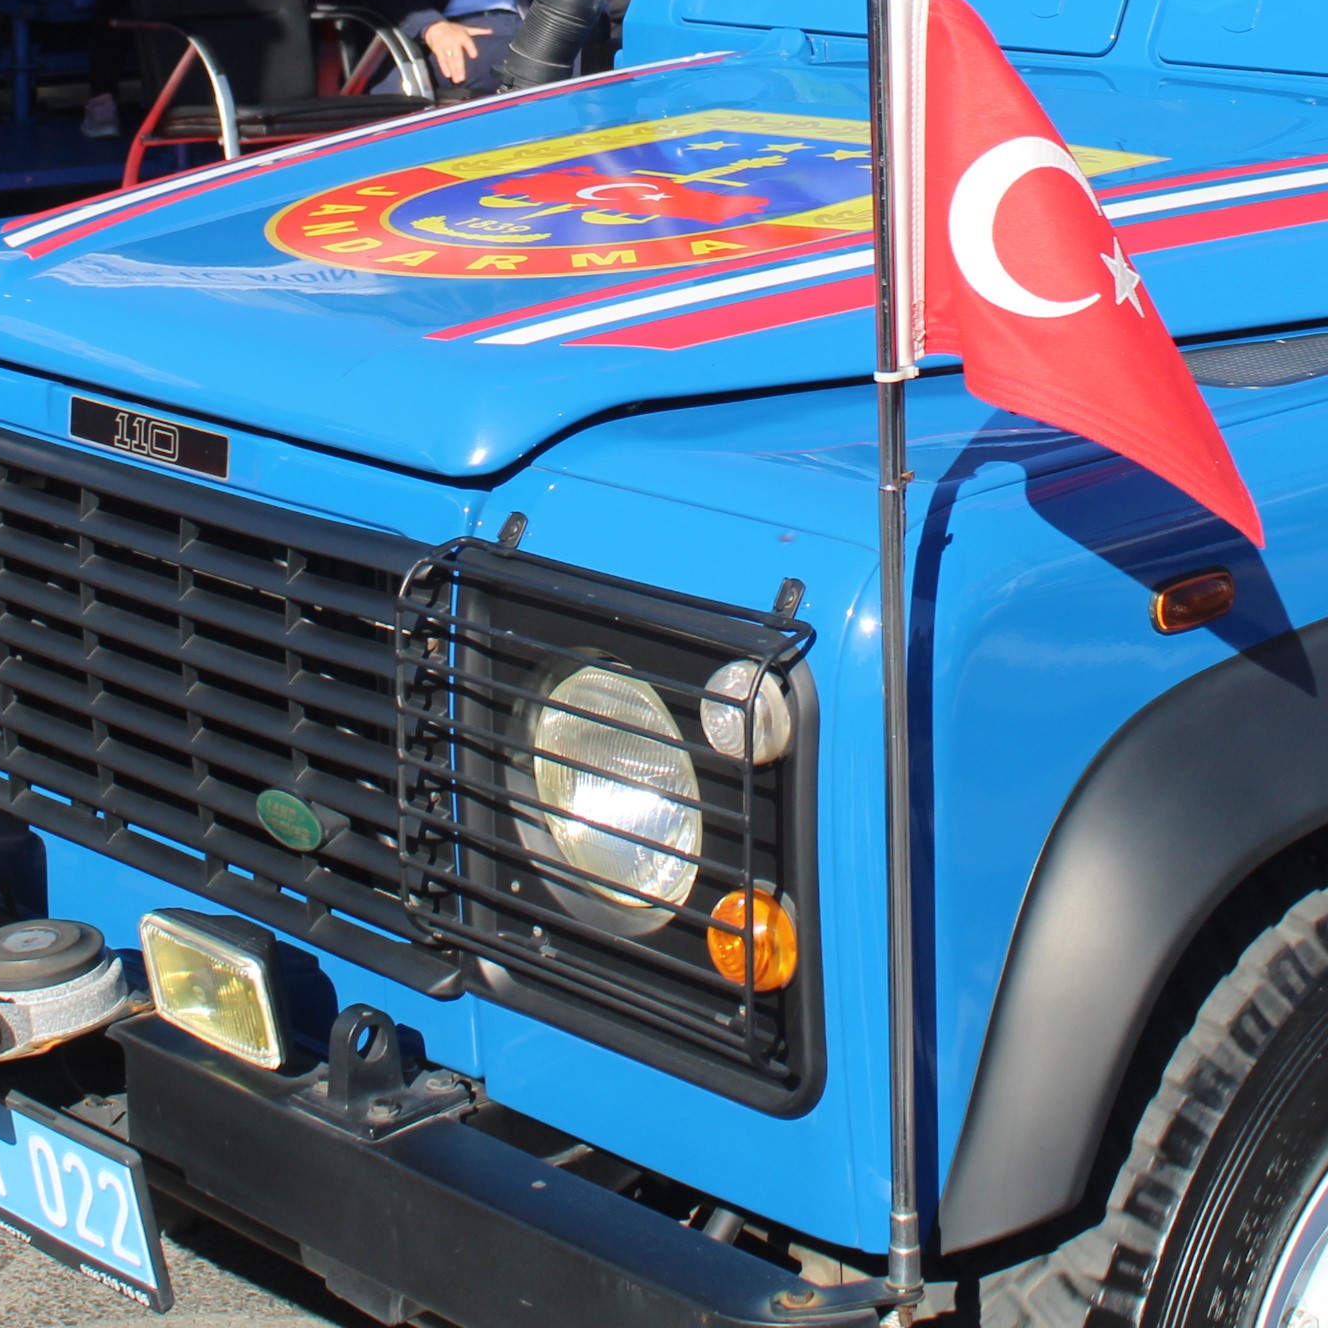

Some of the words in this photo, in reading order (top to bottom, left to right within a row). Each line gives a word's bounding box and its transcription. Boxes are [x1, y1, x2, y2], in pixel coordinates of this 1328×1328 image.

[301, 185, 748, 270] JANDARMA
[454, 215, 534, 235] 1839
[114, 412, 179, 462] 110
[27, 1134, 142, 1267] 022
